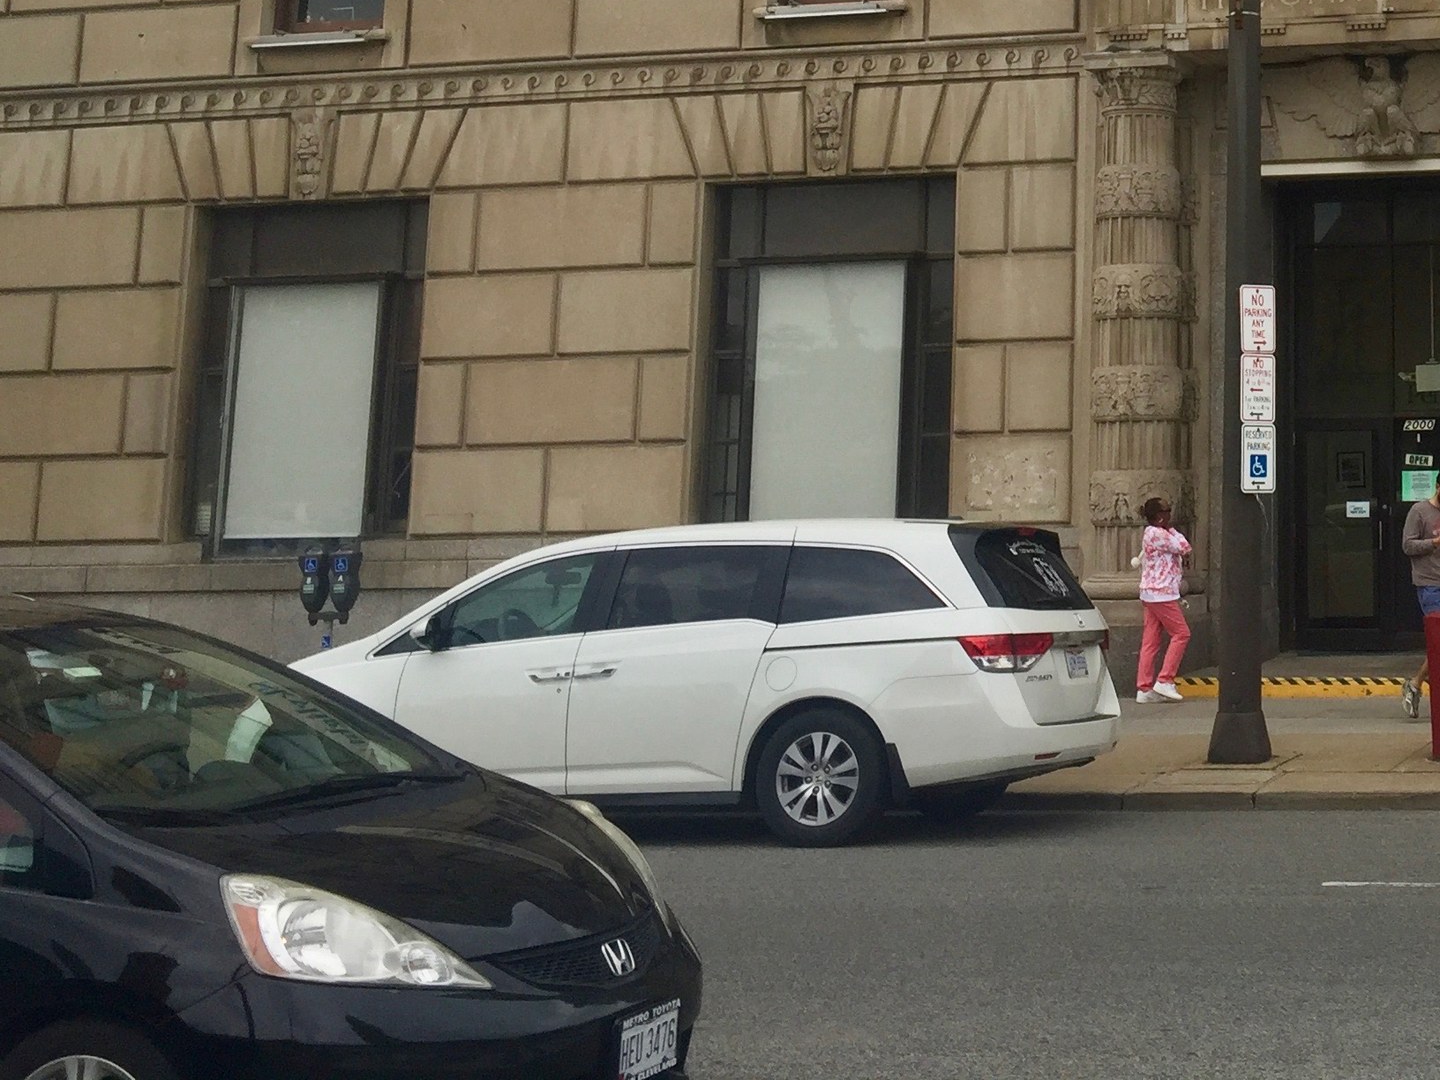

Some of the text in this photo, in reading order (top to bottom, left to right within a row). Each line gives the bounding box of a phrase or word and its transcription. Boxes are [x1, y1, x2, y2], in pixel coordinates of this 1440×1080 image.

[1251, 294, 1265, 306] NO
[1244, 307, 1272, 318] PARKING
[1252, 319, 1265, 328] ANY
[1251, 329, 1266, 339] TIME
[1252, 359, 1265, 369] NO
[1244, 369, 1272, 377] STOPPING
[1404, 420, 1434, 430] 2000
[1245, 430, 1273, 439] RESERVED
[1247, 441, 1271, 451] PARKING
[1408, 455, 1430, 465] OPEN
[623, 997, 681, 1028] METRO TOYOTA
[620, 1017, 676, 1071] HEU 3476
